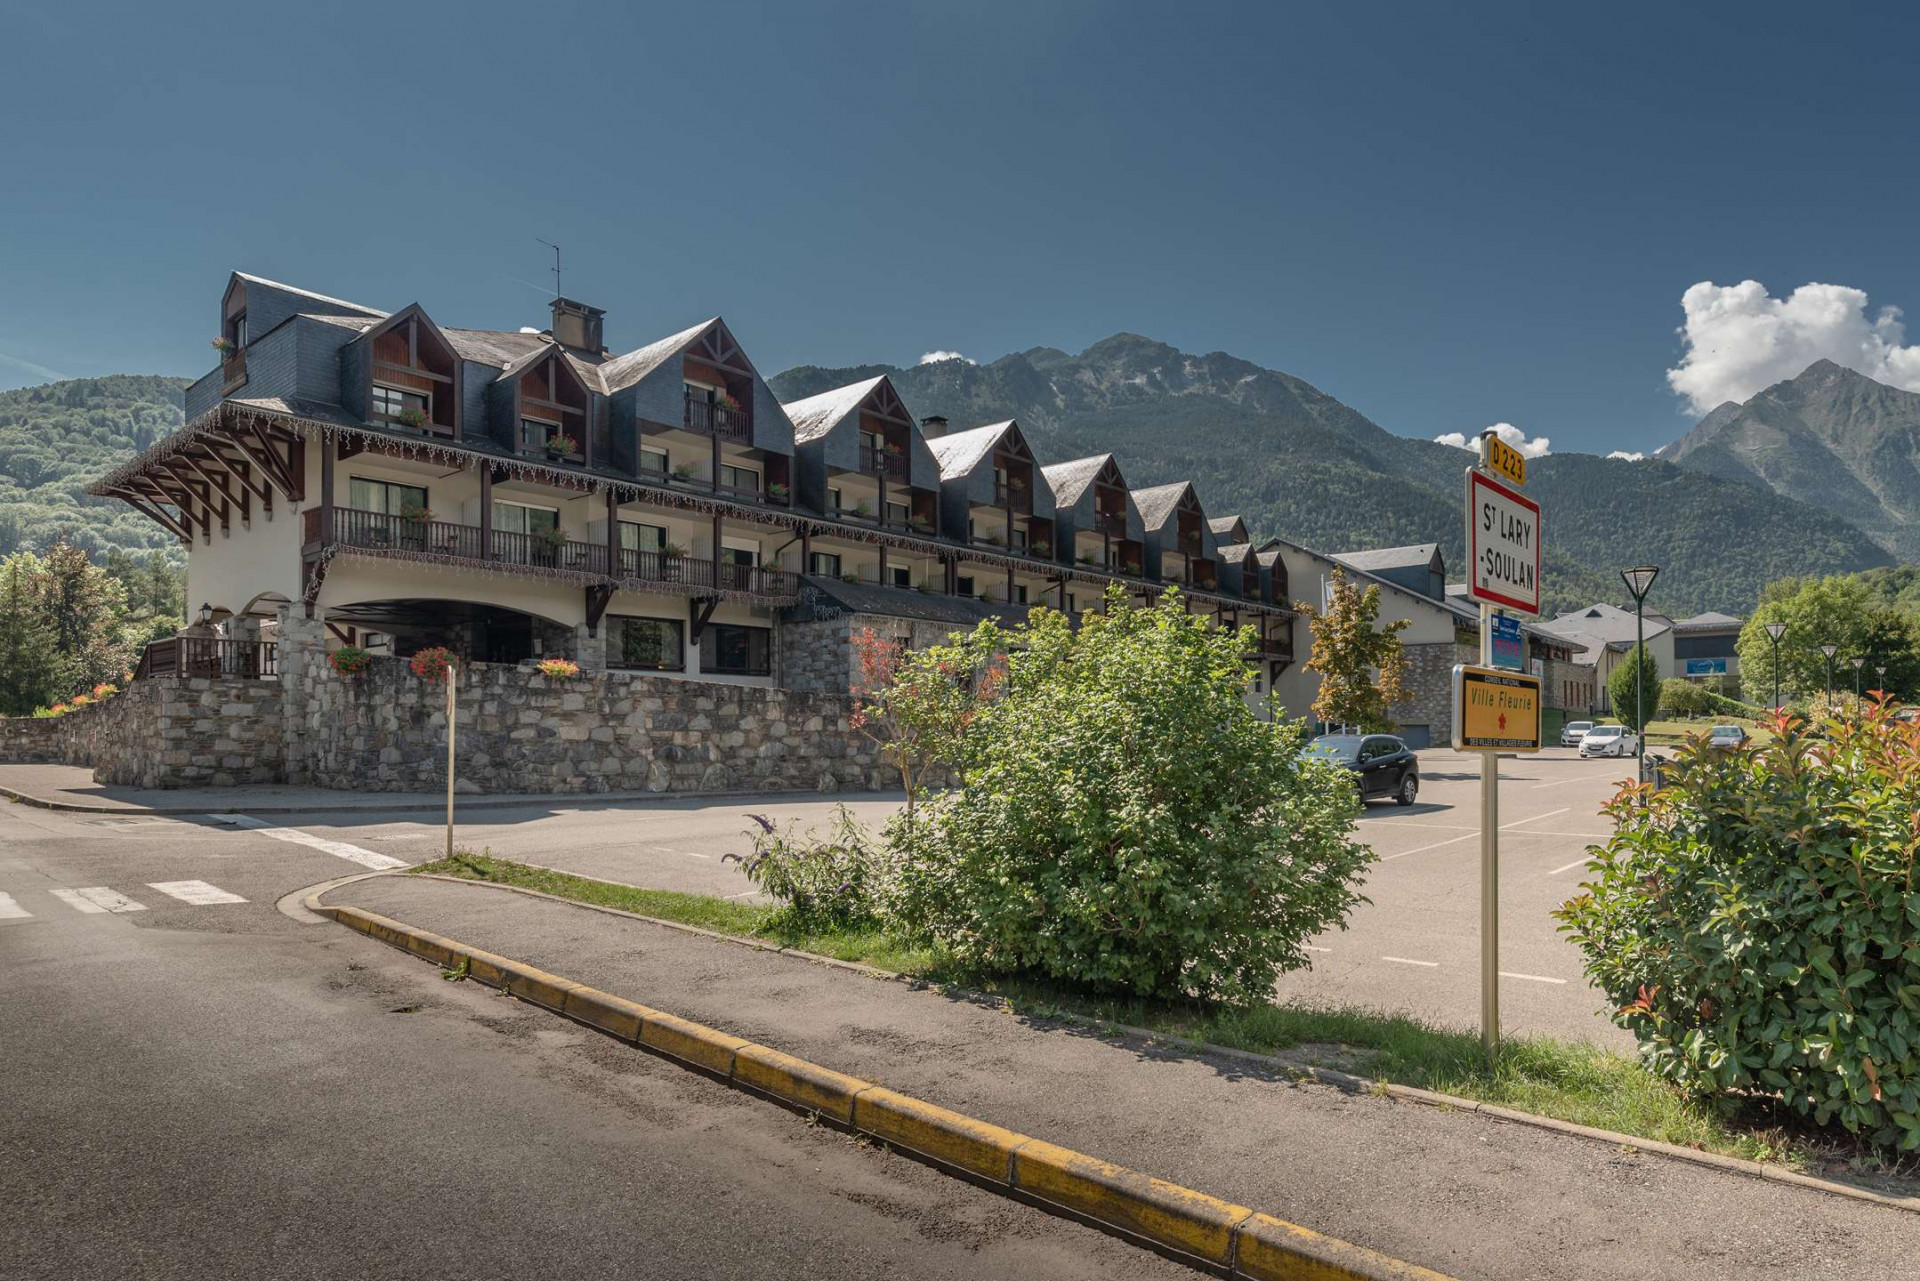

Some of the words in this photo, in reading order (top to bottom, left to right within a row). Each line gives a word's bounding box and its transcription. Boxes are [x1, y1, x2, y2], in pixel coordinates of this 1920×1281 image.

[1493, 442, 1499, 464] D
[1503, 449, 1523, 480] 223
[1500, 510, 1531, 549] LARY
[1471, 687, 1494, 707] Ville
[1499, 691, 1531, 711] Fleurie
